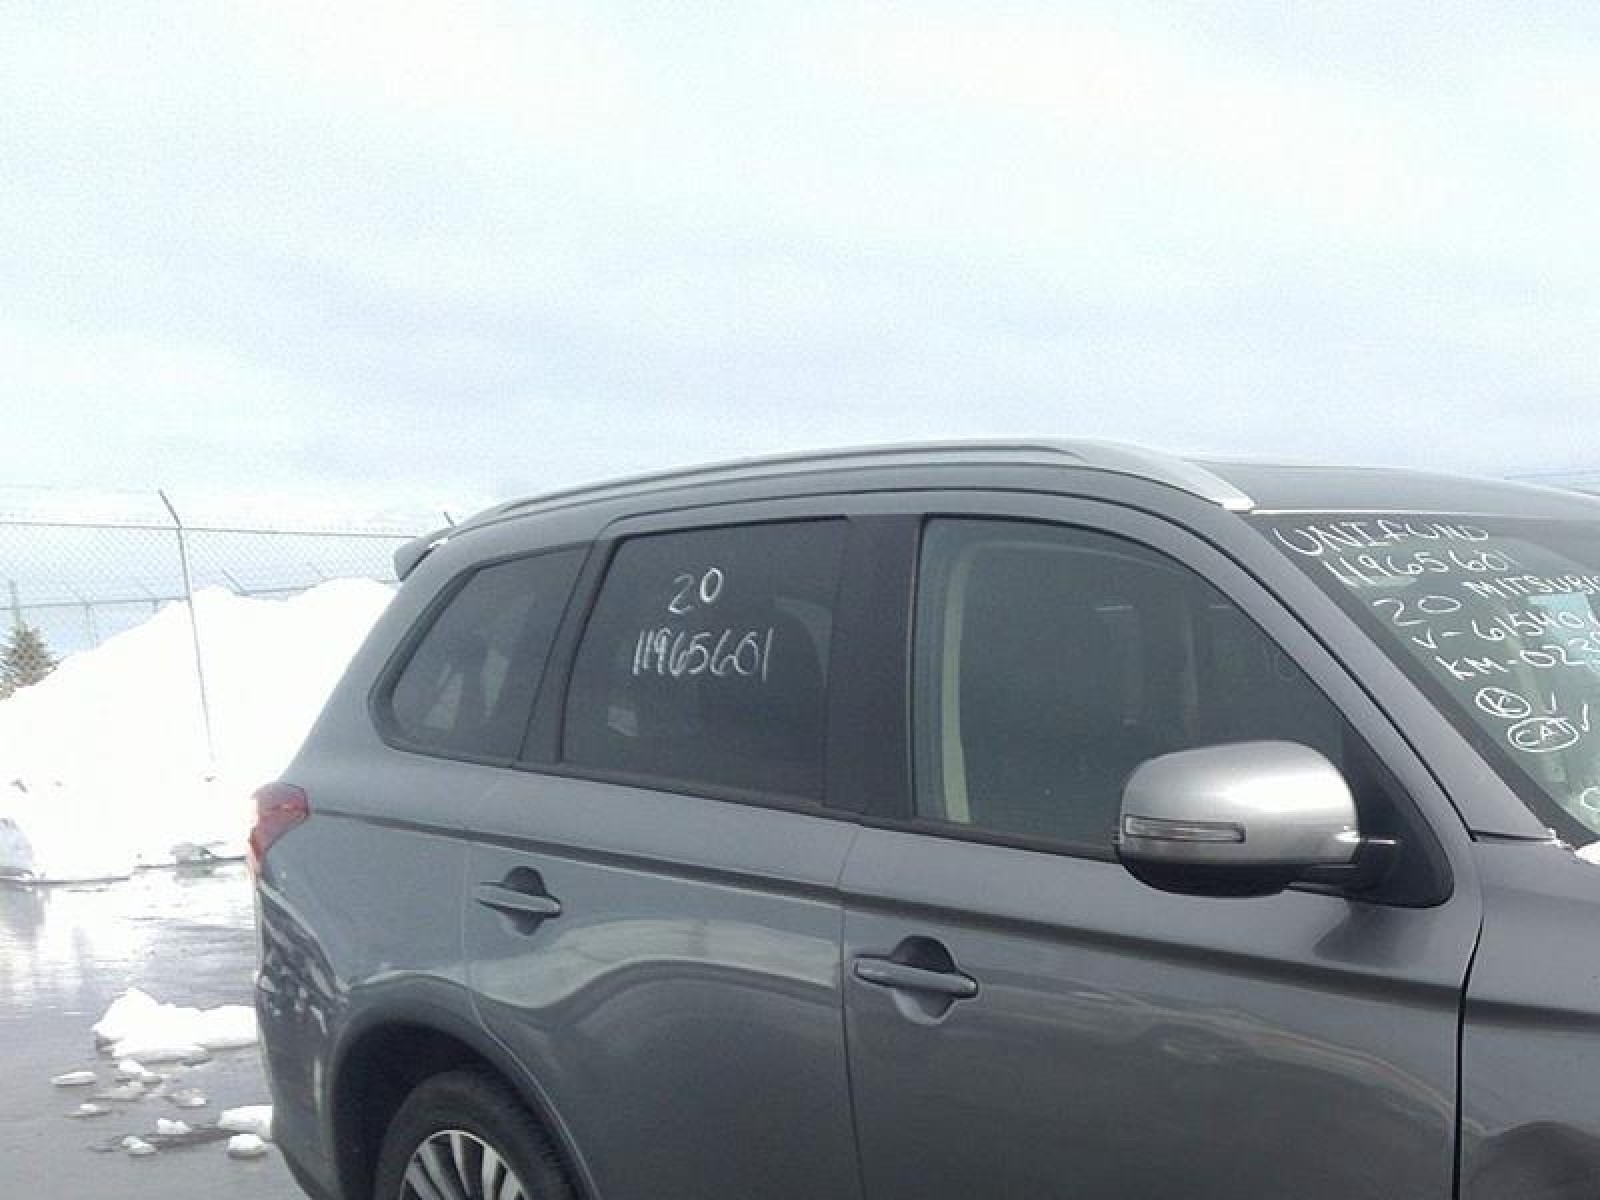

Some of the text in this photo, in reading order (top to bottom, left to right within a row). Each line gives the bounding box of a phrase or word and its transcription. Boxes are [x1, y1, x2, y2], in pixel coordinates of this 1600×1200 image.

[1322, 549, 1521, 588] 11965601
[668, 567, 723, 614] 20
[1373, 595, 1461, 627] 20
[632, 627, 774, 681] 11965601
